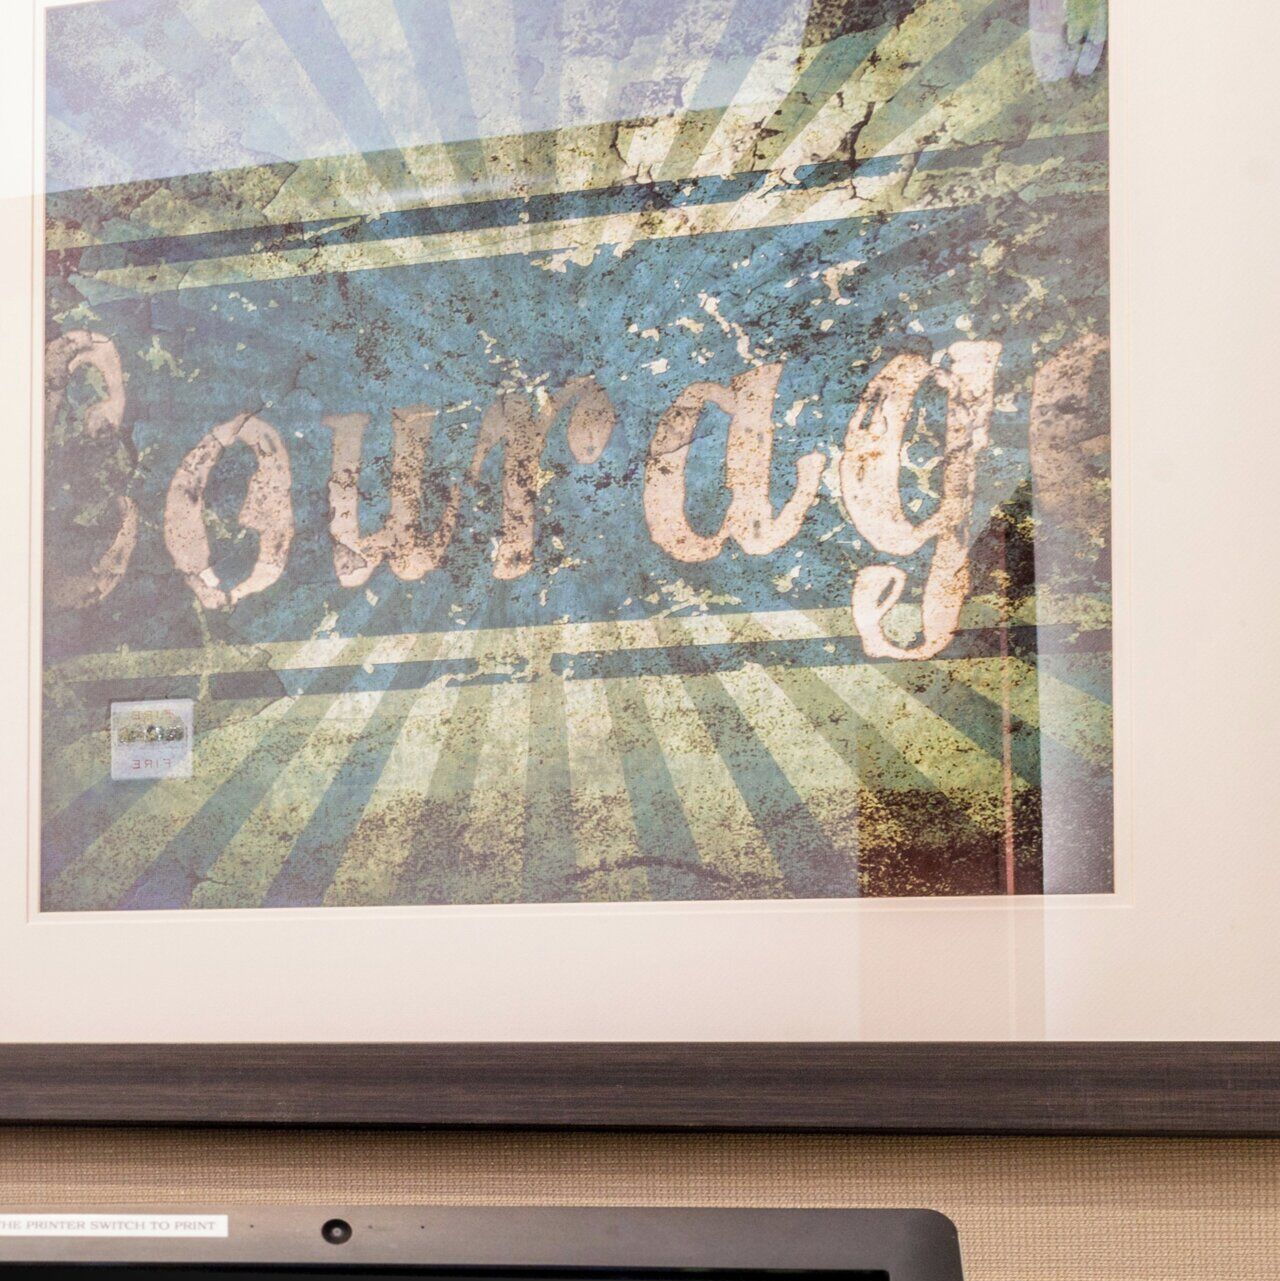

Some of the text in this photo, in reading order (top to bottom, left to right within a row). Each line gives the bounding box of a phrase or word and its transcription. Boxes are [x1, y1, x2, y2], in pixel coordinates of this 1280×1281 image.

[26, 1220, 86, 1230] PRINTER
[89, 1220, 145, 1231] SWITCH
[149, 1221, 170, 1231] TO
[174, 1221, 216, 1231] PRINT
